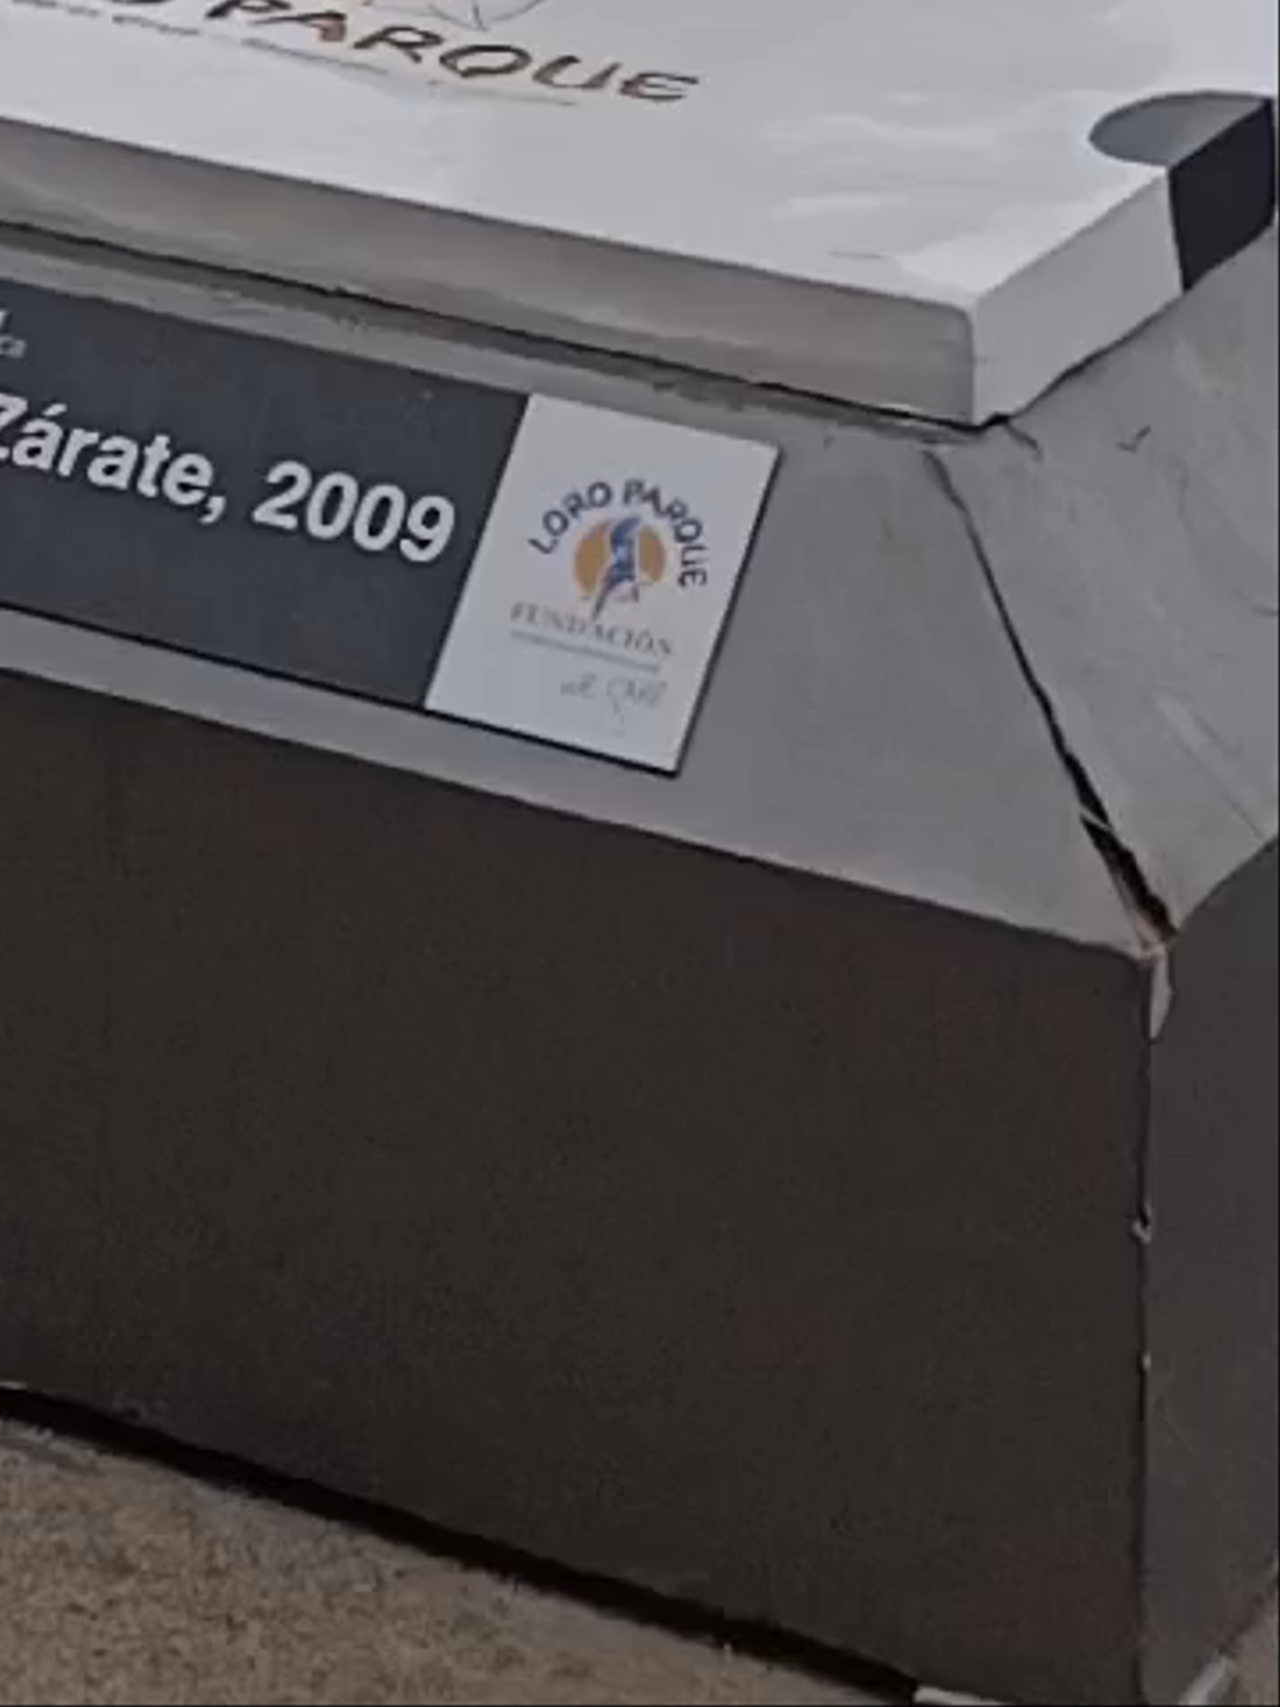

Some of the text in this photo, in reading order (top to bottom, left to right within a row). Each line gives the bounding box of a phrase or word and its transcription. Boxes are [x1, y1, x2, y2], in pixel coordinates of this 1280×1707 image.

[252, 460, 456, 563] 2009
[528, 477, 708, 589] LORO PARQUE
